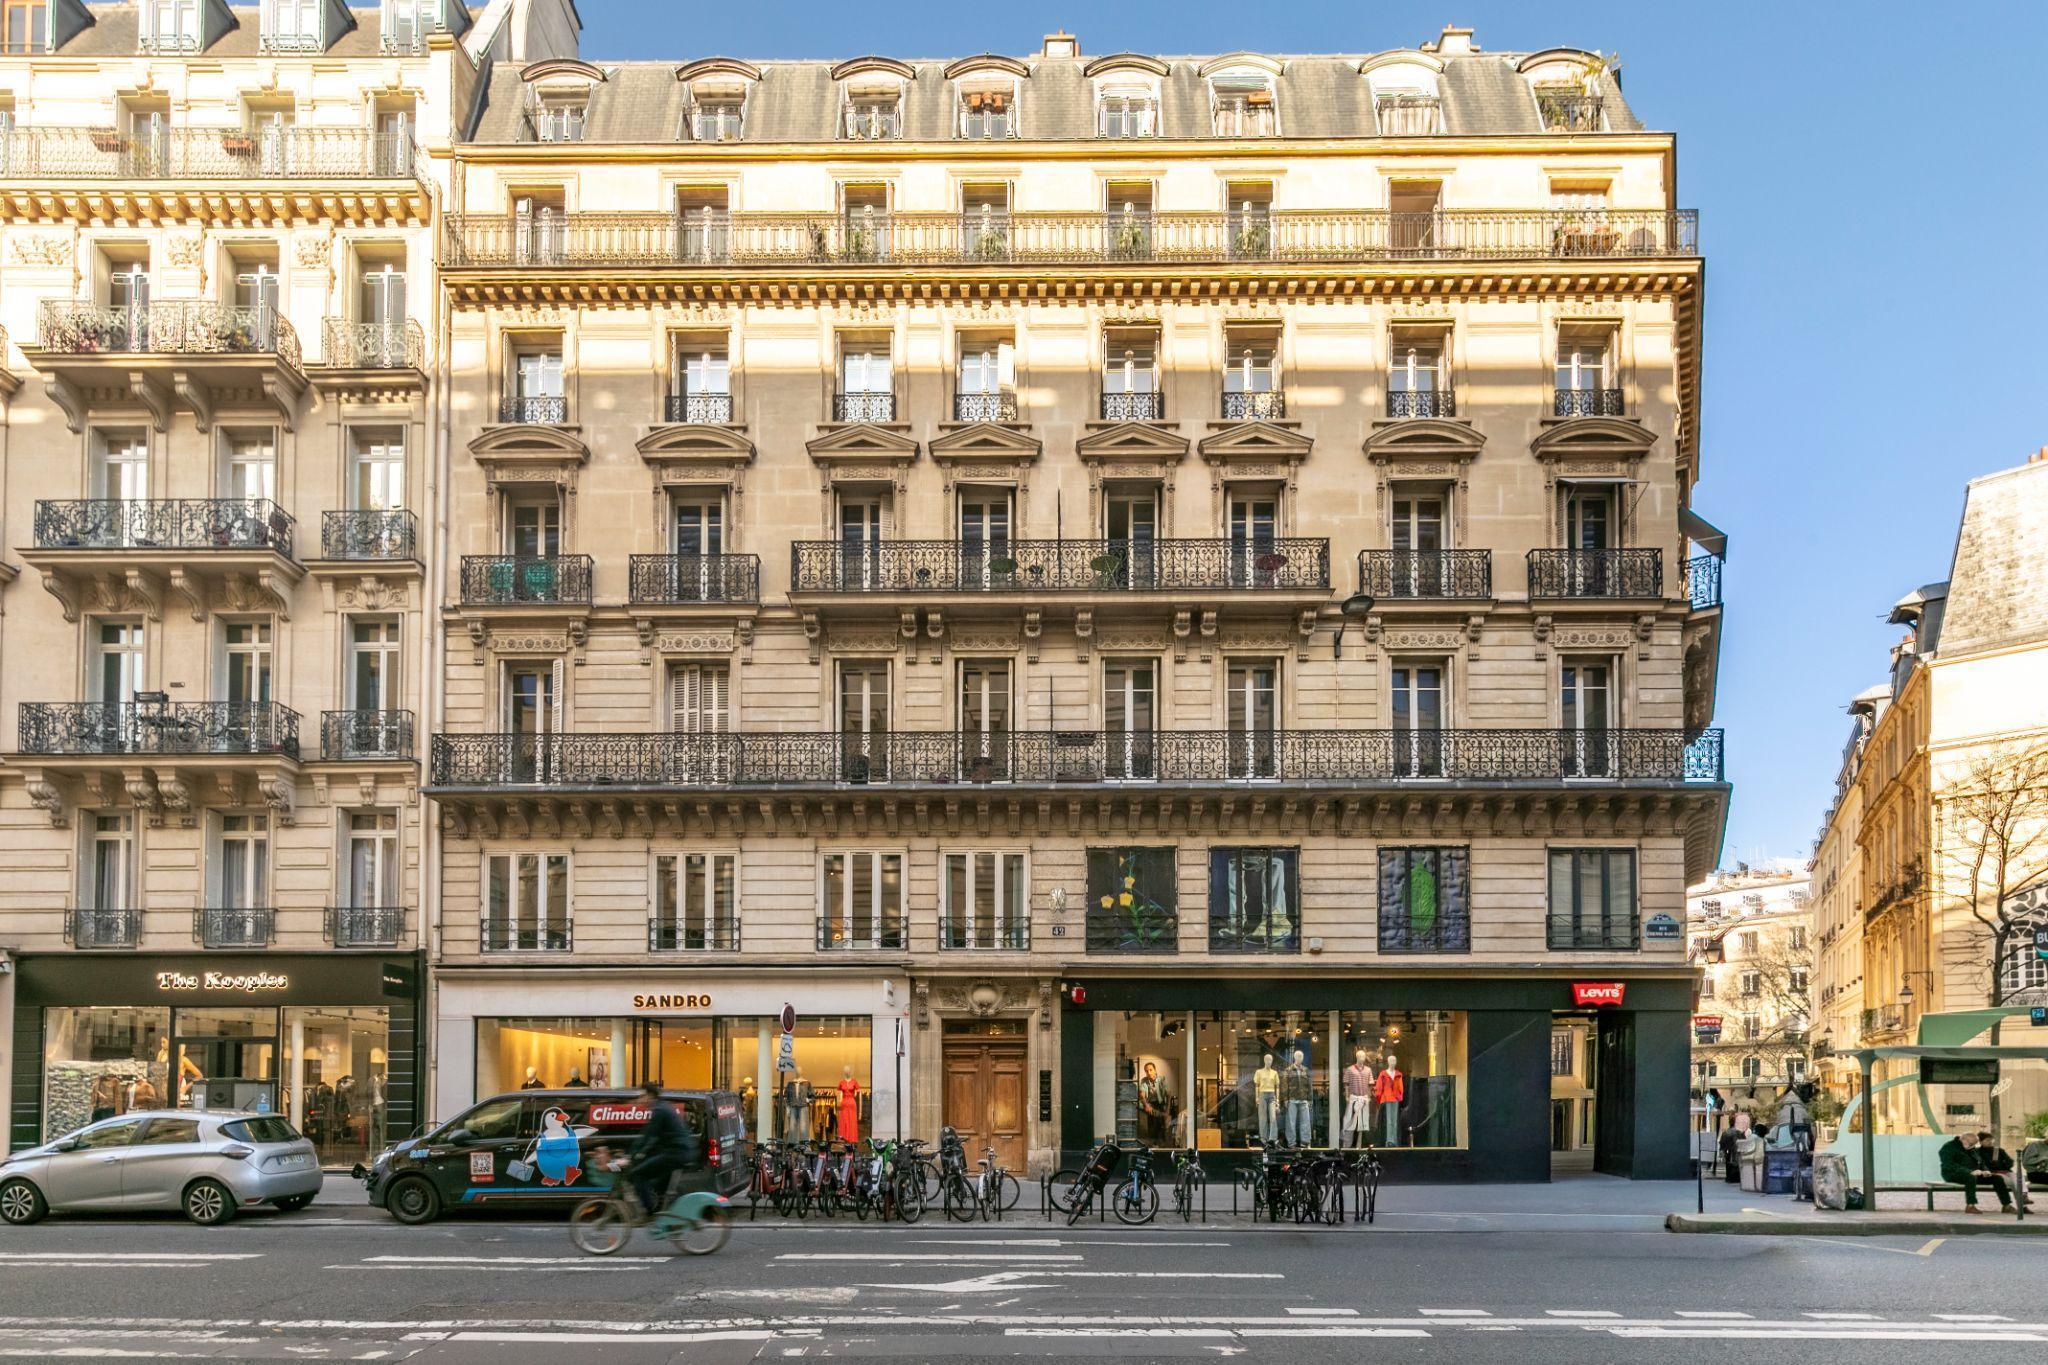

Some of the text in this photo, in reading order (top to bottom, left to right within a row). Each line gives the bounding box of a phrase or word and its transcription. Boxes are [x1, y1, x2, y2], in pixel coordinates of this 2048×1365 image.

[158, 972, 287, 991] The Kooples
[633, 995, 712, 1007] SANDRO
